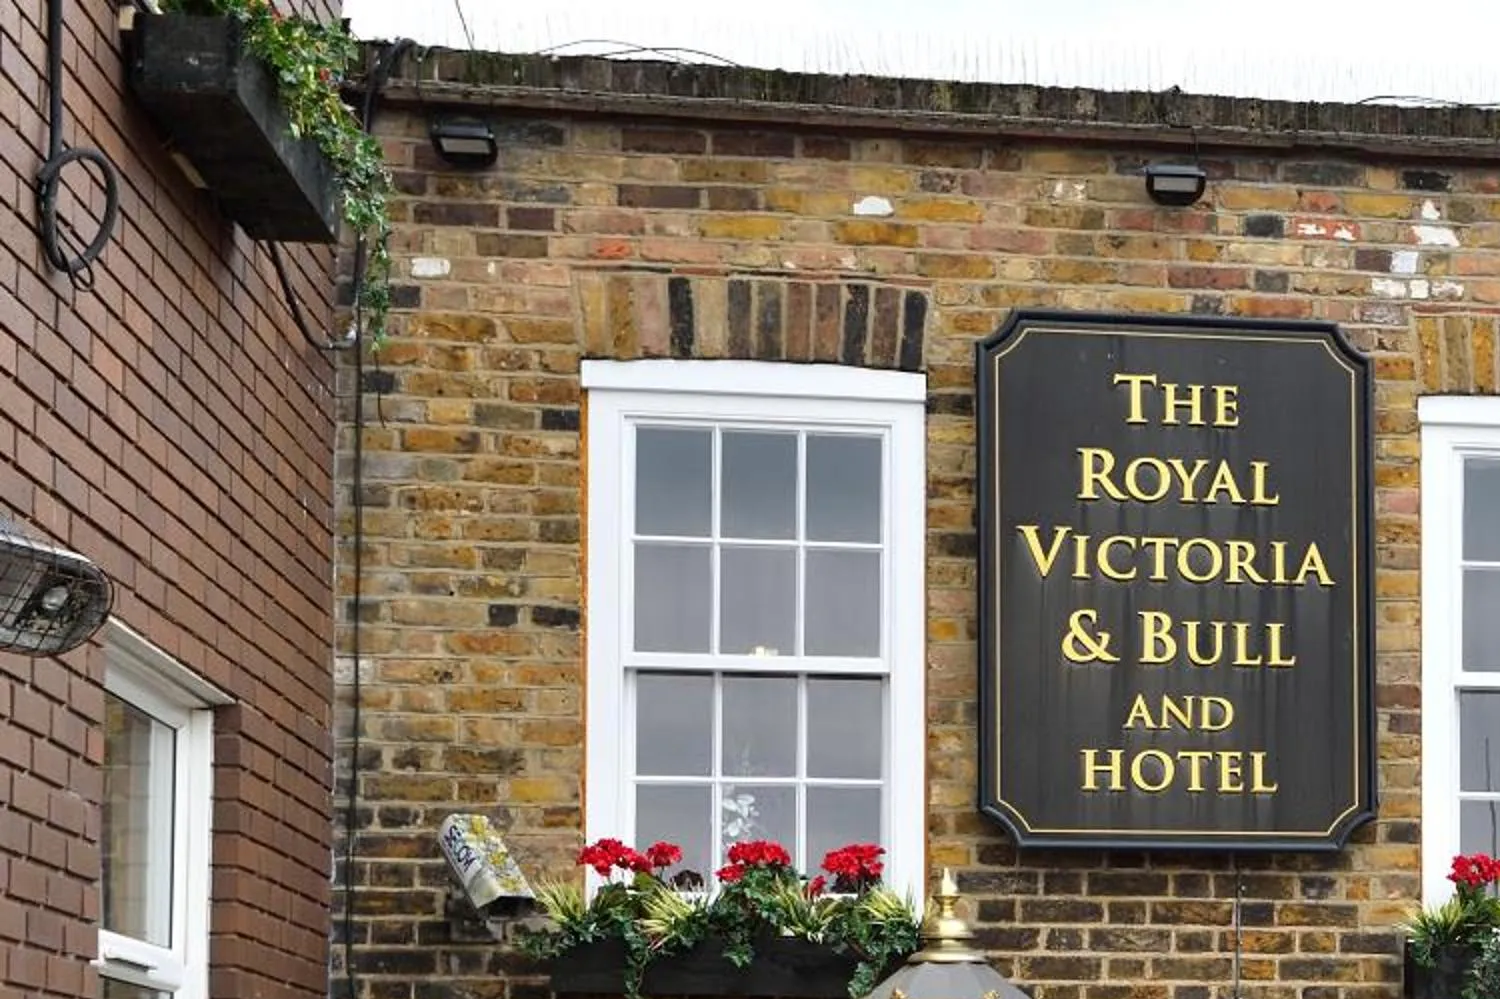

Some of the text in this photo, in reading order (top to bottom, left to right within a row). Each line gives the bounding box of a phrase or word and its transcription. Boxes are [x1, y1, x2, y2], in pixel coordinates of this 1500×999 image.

[1061, 608, 1119, 663] &
[1124, 694, 1234, 731] AND
[1080, 748, 1278, 794] HOTEL
